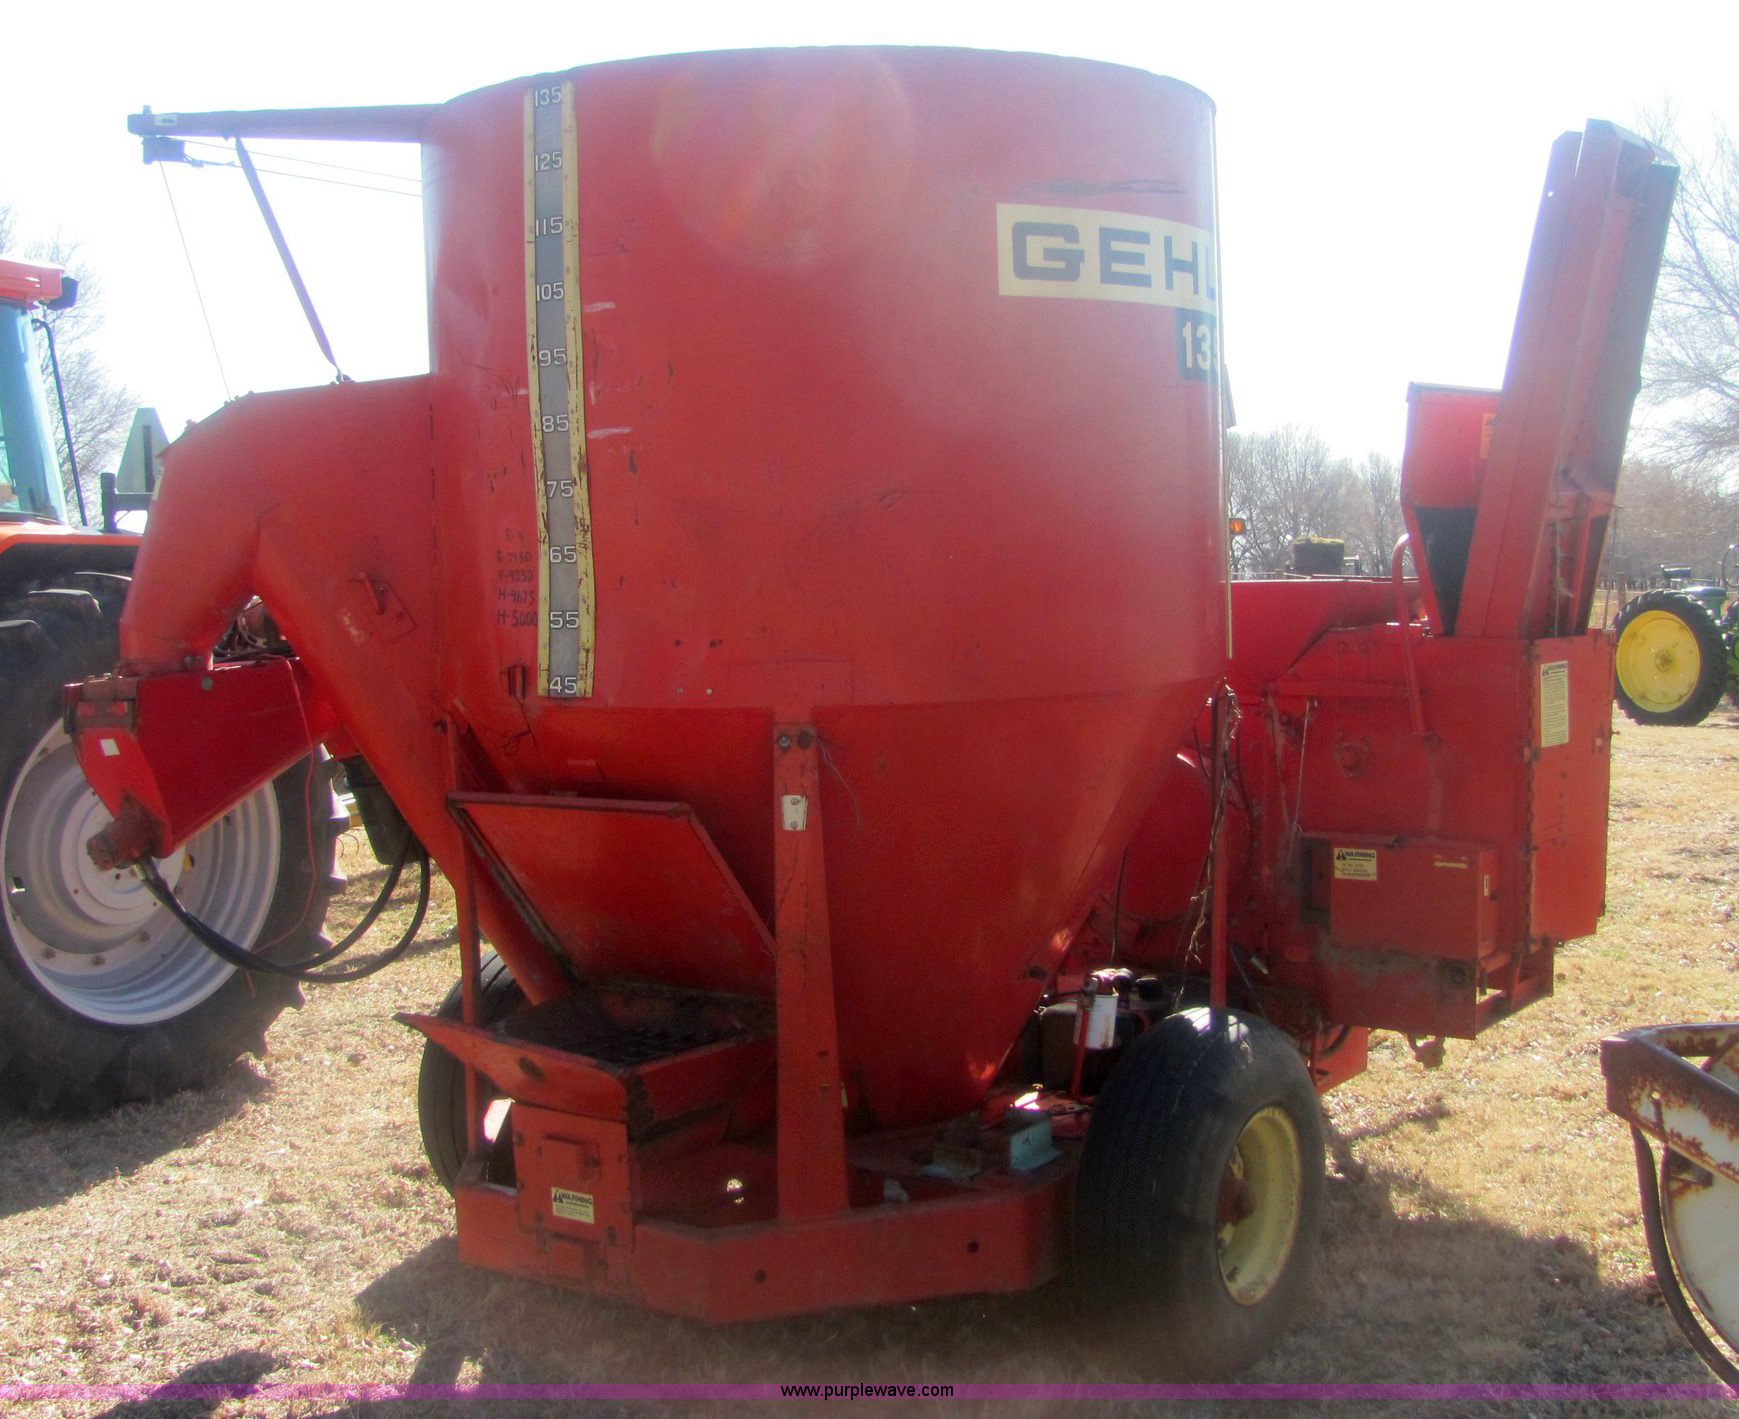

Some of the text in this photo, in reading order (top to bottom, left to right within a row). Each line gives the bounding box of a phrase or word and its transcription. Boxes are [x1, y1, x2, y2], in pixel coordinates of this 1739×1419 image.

[534, 86, 562, 107] 135
[535, 151, 562, 172] 125
[535, 216, 563, 237] 115
[536, 282, 565, 302] 105
[538, 348, 567, 367] 95
[542, 414, 569, 433] 85
[546, 480, 573, 498] 75
[549, 546, 577, 563] 65
[550, 611, 579, 629] 55
[549, 677, 577, 694] 45
